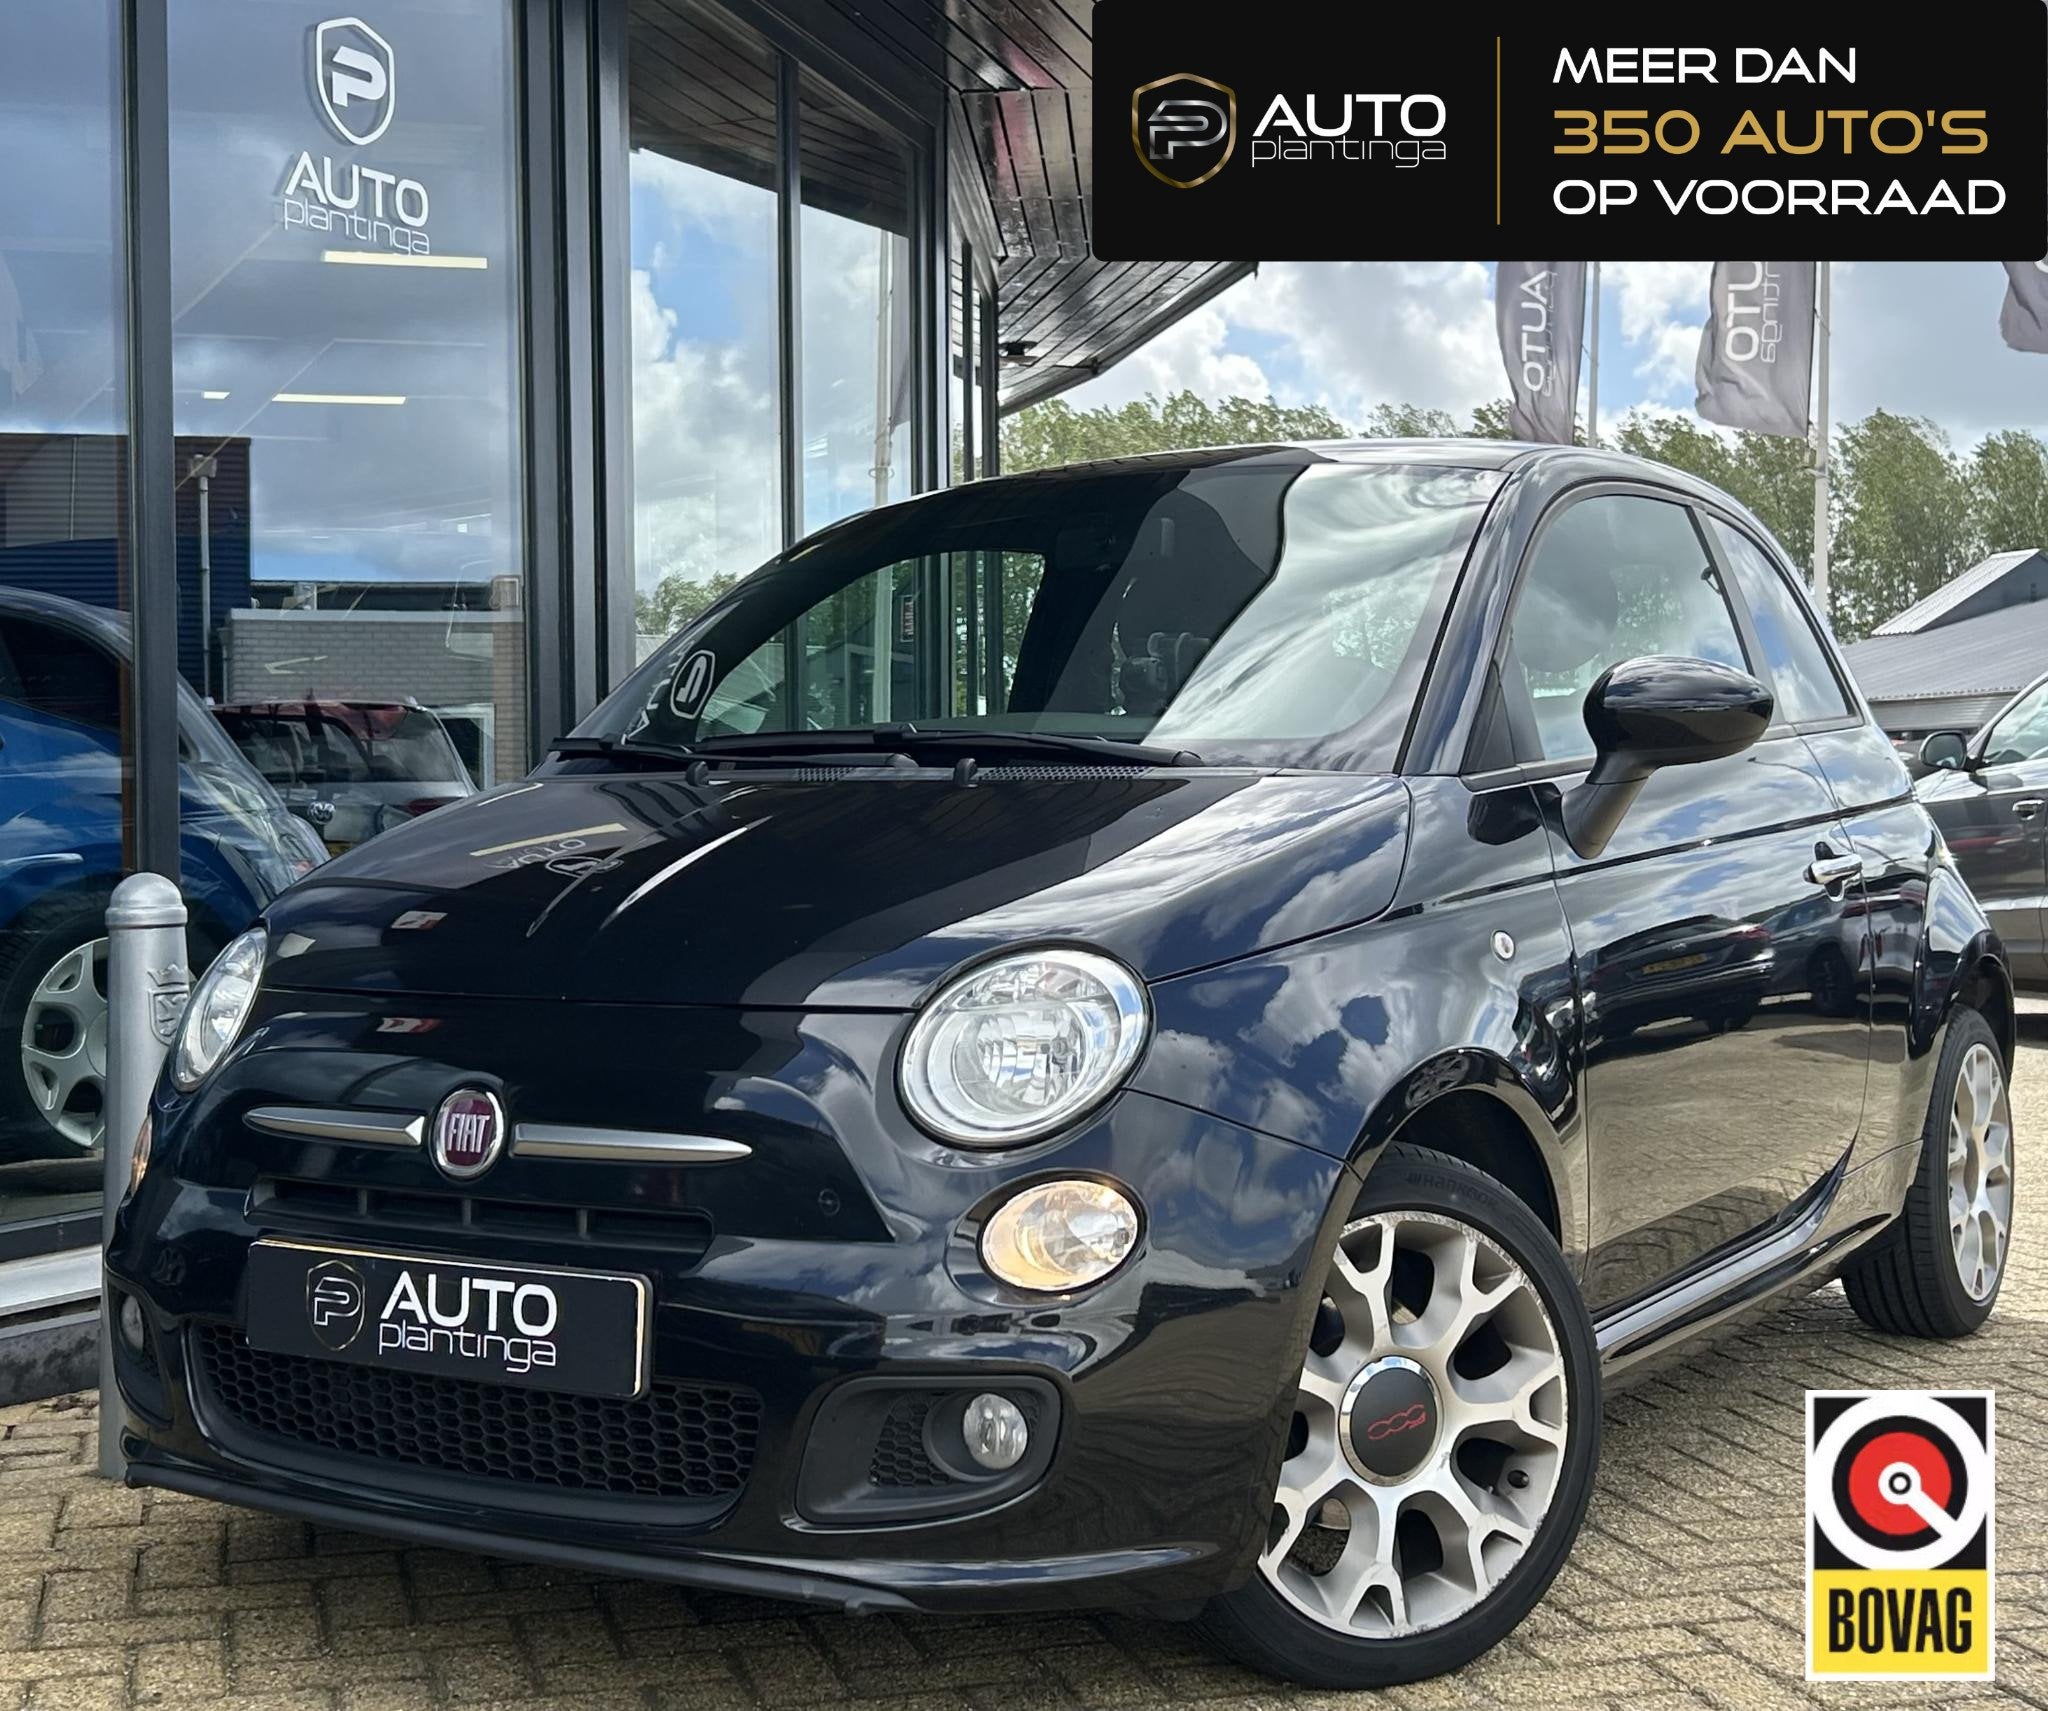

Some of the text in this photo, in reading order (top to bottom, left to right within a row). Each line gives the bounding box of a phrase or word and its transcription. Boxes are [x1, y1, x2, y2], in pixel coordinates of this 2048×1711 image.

[331, 45, 388, 108] P
[285, 151, 429, 228] AUTO
[283, 198, 431, 257] plantinga
[447, 1112, 491, 1153] FIAT
[313, 1276, 361, 1326] P
[380, 1270, 558, 1337] AUTO
[378, 1319, 557, 1373] plantinga
